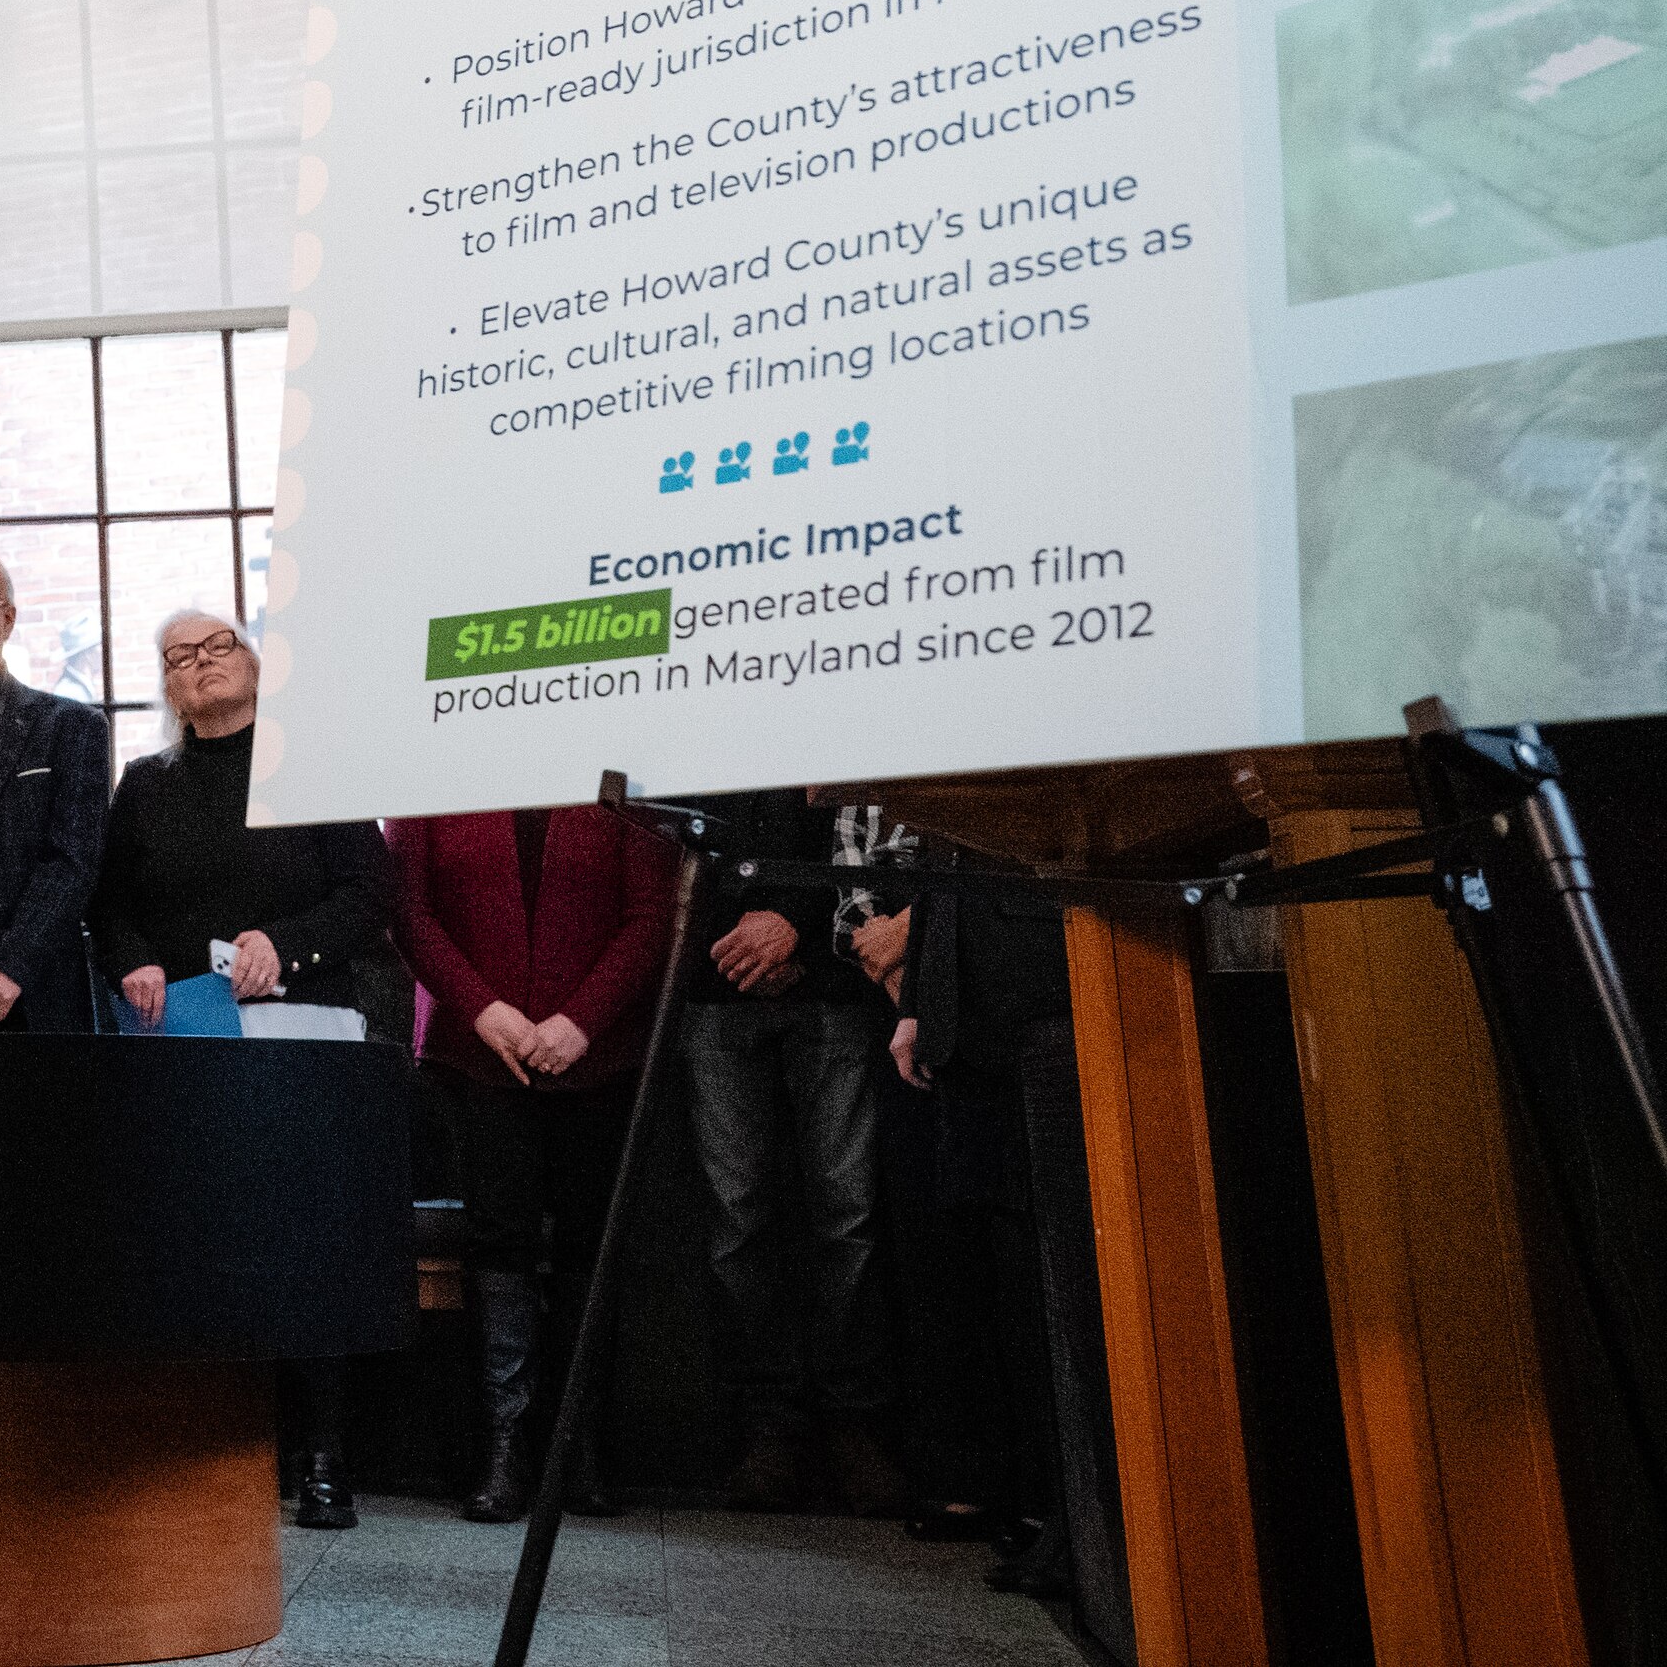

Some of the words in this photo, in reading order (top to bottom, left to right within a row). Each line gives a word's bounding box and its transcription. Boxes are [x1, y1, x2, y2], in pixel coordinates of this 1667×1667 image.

[420, 150, 621, 219] Strengthen
[631, 132, 695, 169] the
[889, 4, 1204, 106] attractiveness
[452, 27, 591, 85] Position
[460, 58, 646, 130] film-ready
[649, 1, 871, 89] jurisdiction
[460, 229, 497, 258] to
[505, 210, 577, 249] film
[587, 183, 659, 230] and
[669, 146, 856, 211] television
[870, 78, 1137, 173] productions
[417, 347, 555, 400] historic,
[565, 311, 720, 371] cultural,
[732, 291, 808, 340] and
[822, 257, 973, 322] natural
[987, 235, 1129, 289] assets
[1141, 221, 1194, 258] as
[479, 288, 611, 338] Elevate
[622, 244, 771, 308] Howard
[978, 174, 1139, 232] unique
[488, 372, 715, 438] competitive
[725, 343, 874, 396] filming
[889, 302, 1091, 366] locations
[588, 526, 792, 588] Economic
[805, 503, 964, 558] Impact
[672, 569, 890, 641] generated
[903, 562, 1016, 604] from
[1029, 544, 1126, 587] film
[432, 664, 641, 724] production
[655, 656, 690, 693] in
[704, 628, 902, 688] Maryland
[916, 622, 1037, 664] since
[1050, 599, 1155, 649] 2012
[453, 618, 529, 665] $1.5
[533, 603, 662, 651] billion
